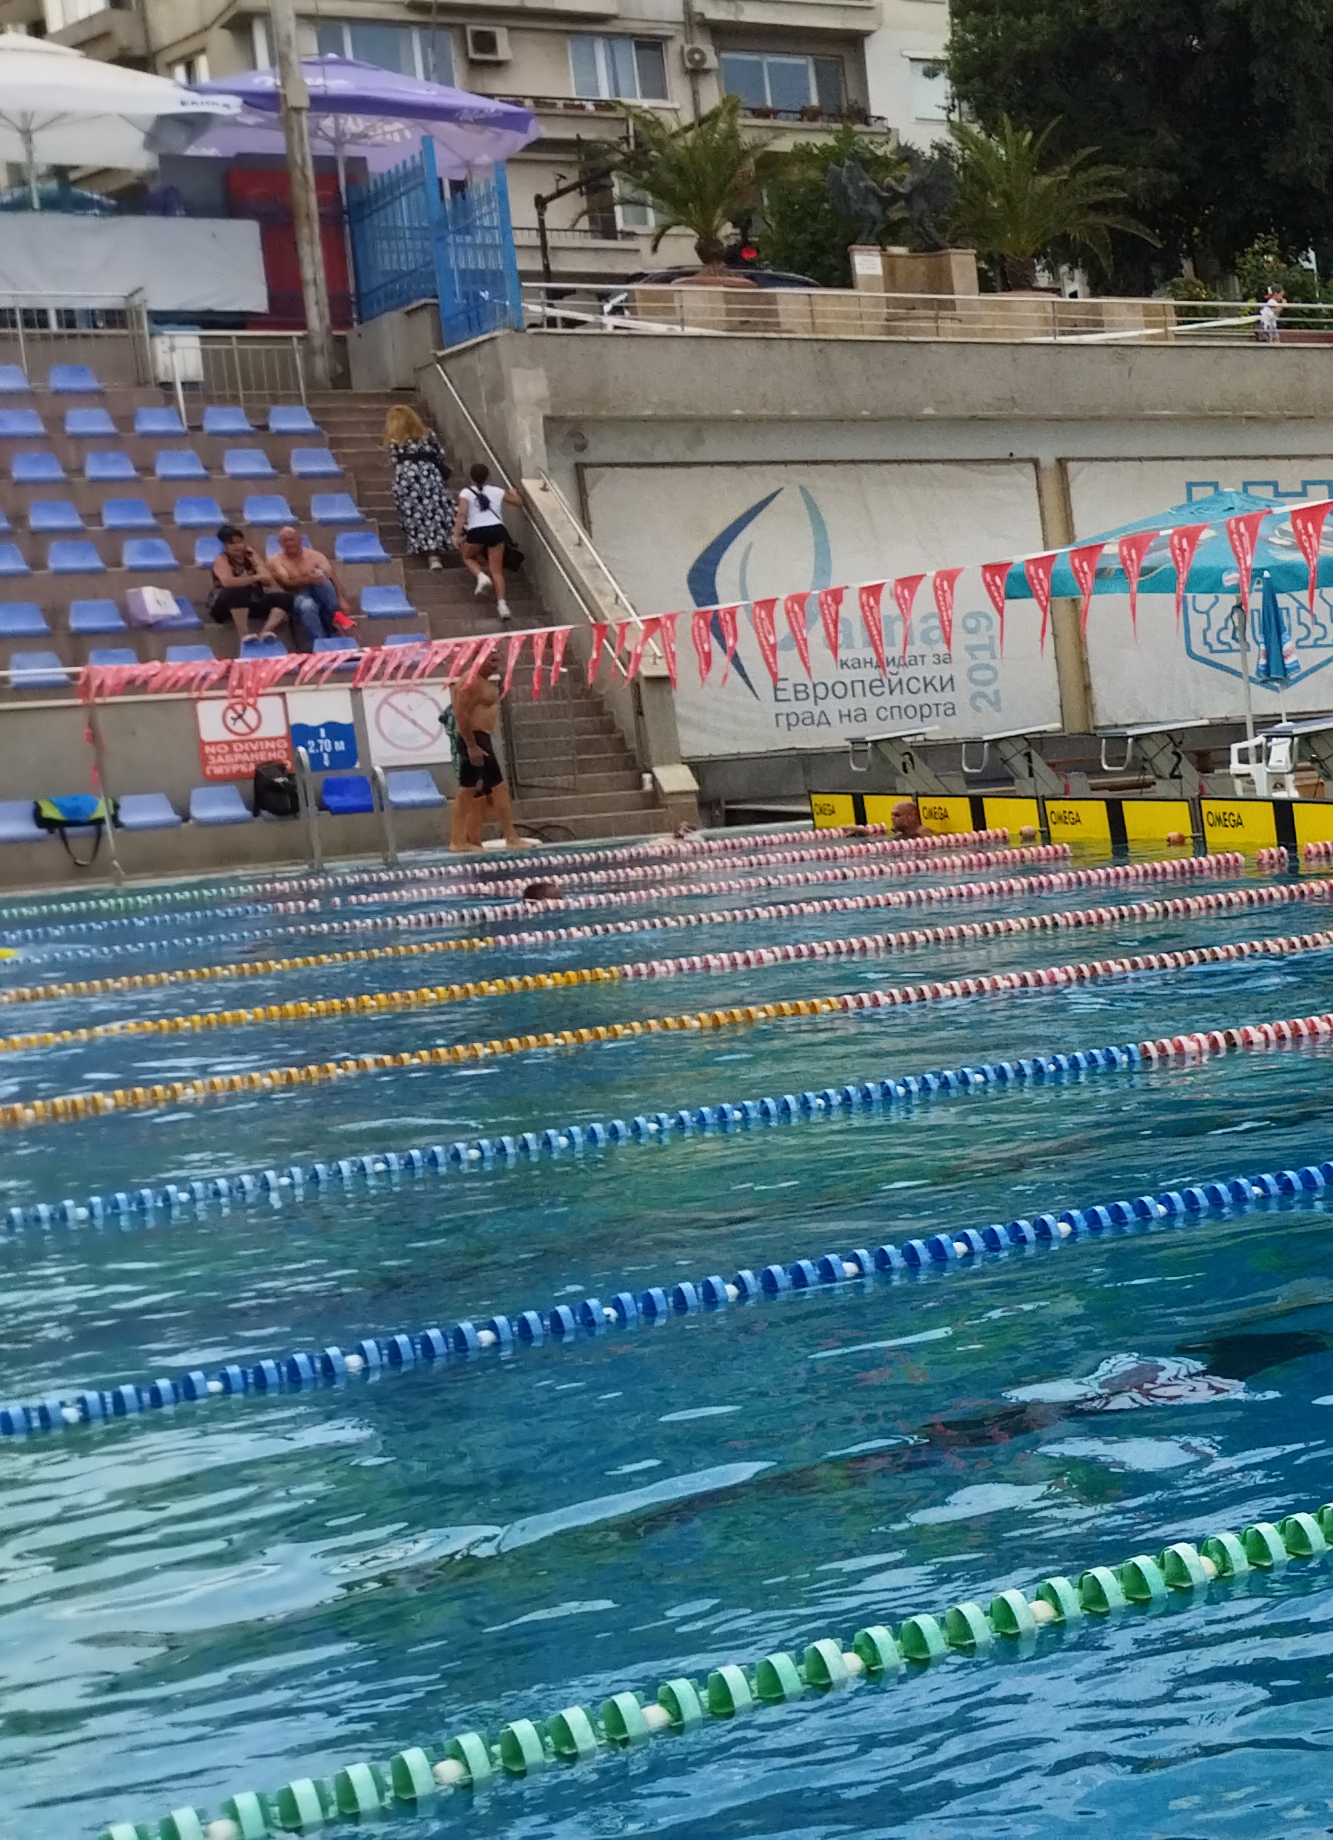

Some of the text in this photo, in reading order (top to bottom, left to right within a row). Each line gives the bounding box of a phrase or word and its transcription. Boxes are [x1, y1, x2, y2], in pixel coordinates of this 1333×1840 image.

[932, 652, 953, 665] за
[962, 610, 1002, 714] 2019
[773, 671, 956, 706] Европейски
[775, 701, 957, 731] град на спорта
[204, 743, 230, 754] NO
[308, 740, 331, 753] 2.70
[922, 806, 949, 820] OMEGA
[1050, 810, 1082, 825] OMEGA
[1207, 811, 1244, 828] OMEGA
